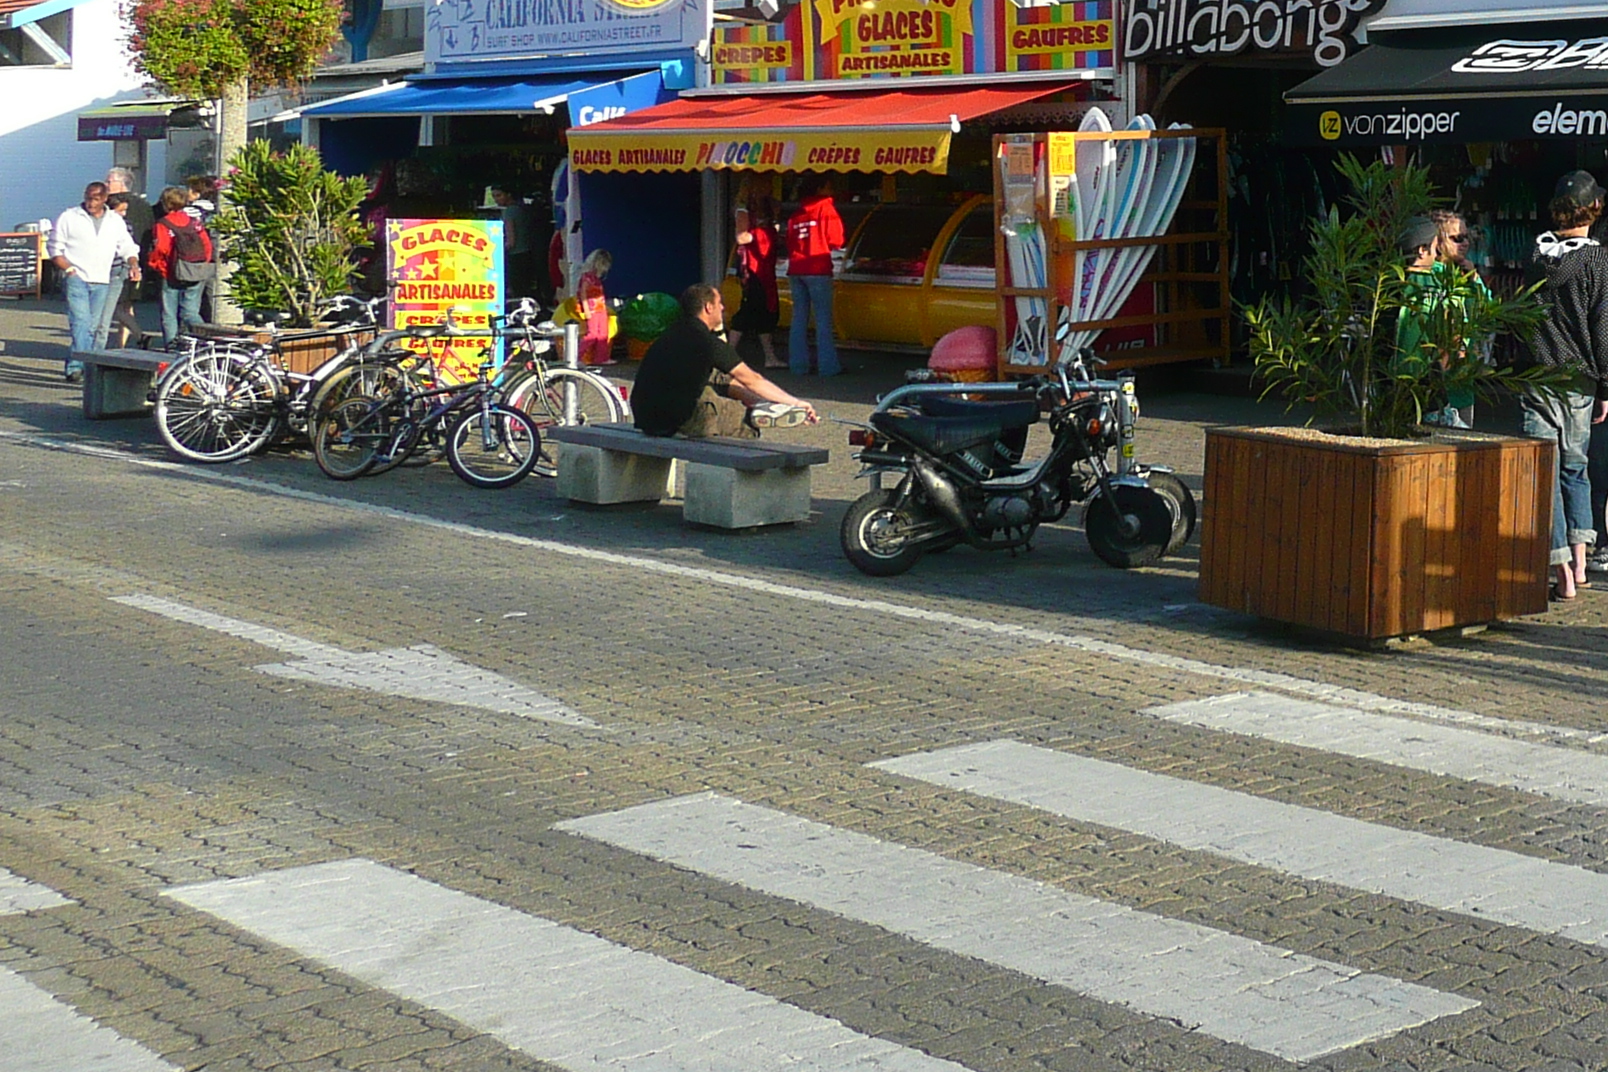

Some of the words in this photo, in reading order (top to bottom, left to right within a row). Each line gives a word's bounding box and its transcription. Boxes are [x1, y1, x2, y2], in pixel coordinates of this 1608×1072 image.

[858, 10, 933, 42] GLACES
[1012, 24, 1109, 49] GAUFRES
[487, 35, 508, 48] SURF
[512, 33, 534, 47] SHOP
[716, 46, 786, 64] CREPES
[842, 52, 951, 70] ARTISANALES
[1345, 107, 1460, 139] vonzipper
[573, 149, 612, 165] GLACES
[618, 148, 686, 165] ARTISANALES
[696, 141, 797, 166] PINOCCHIO
[875, 146, 936, 165] GAUFRES
[402, 229, 488, 252] GLACES
[397, 283, 495, 300] ARTISANALES
